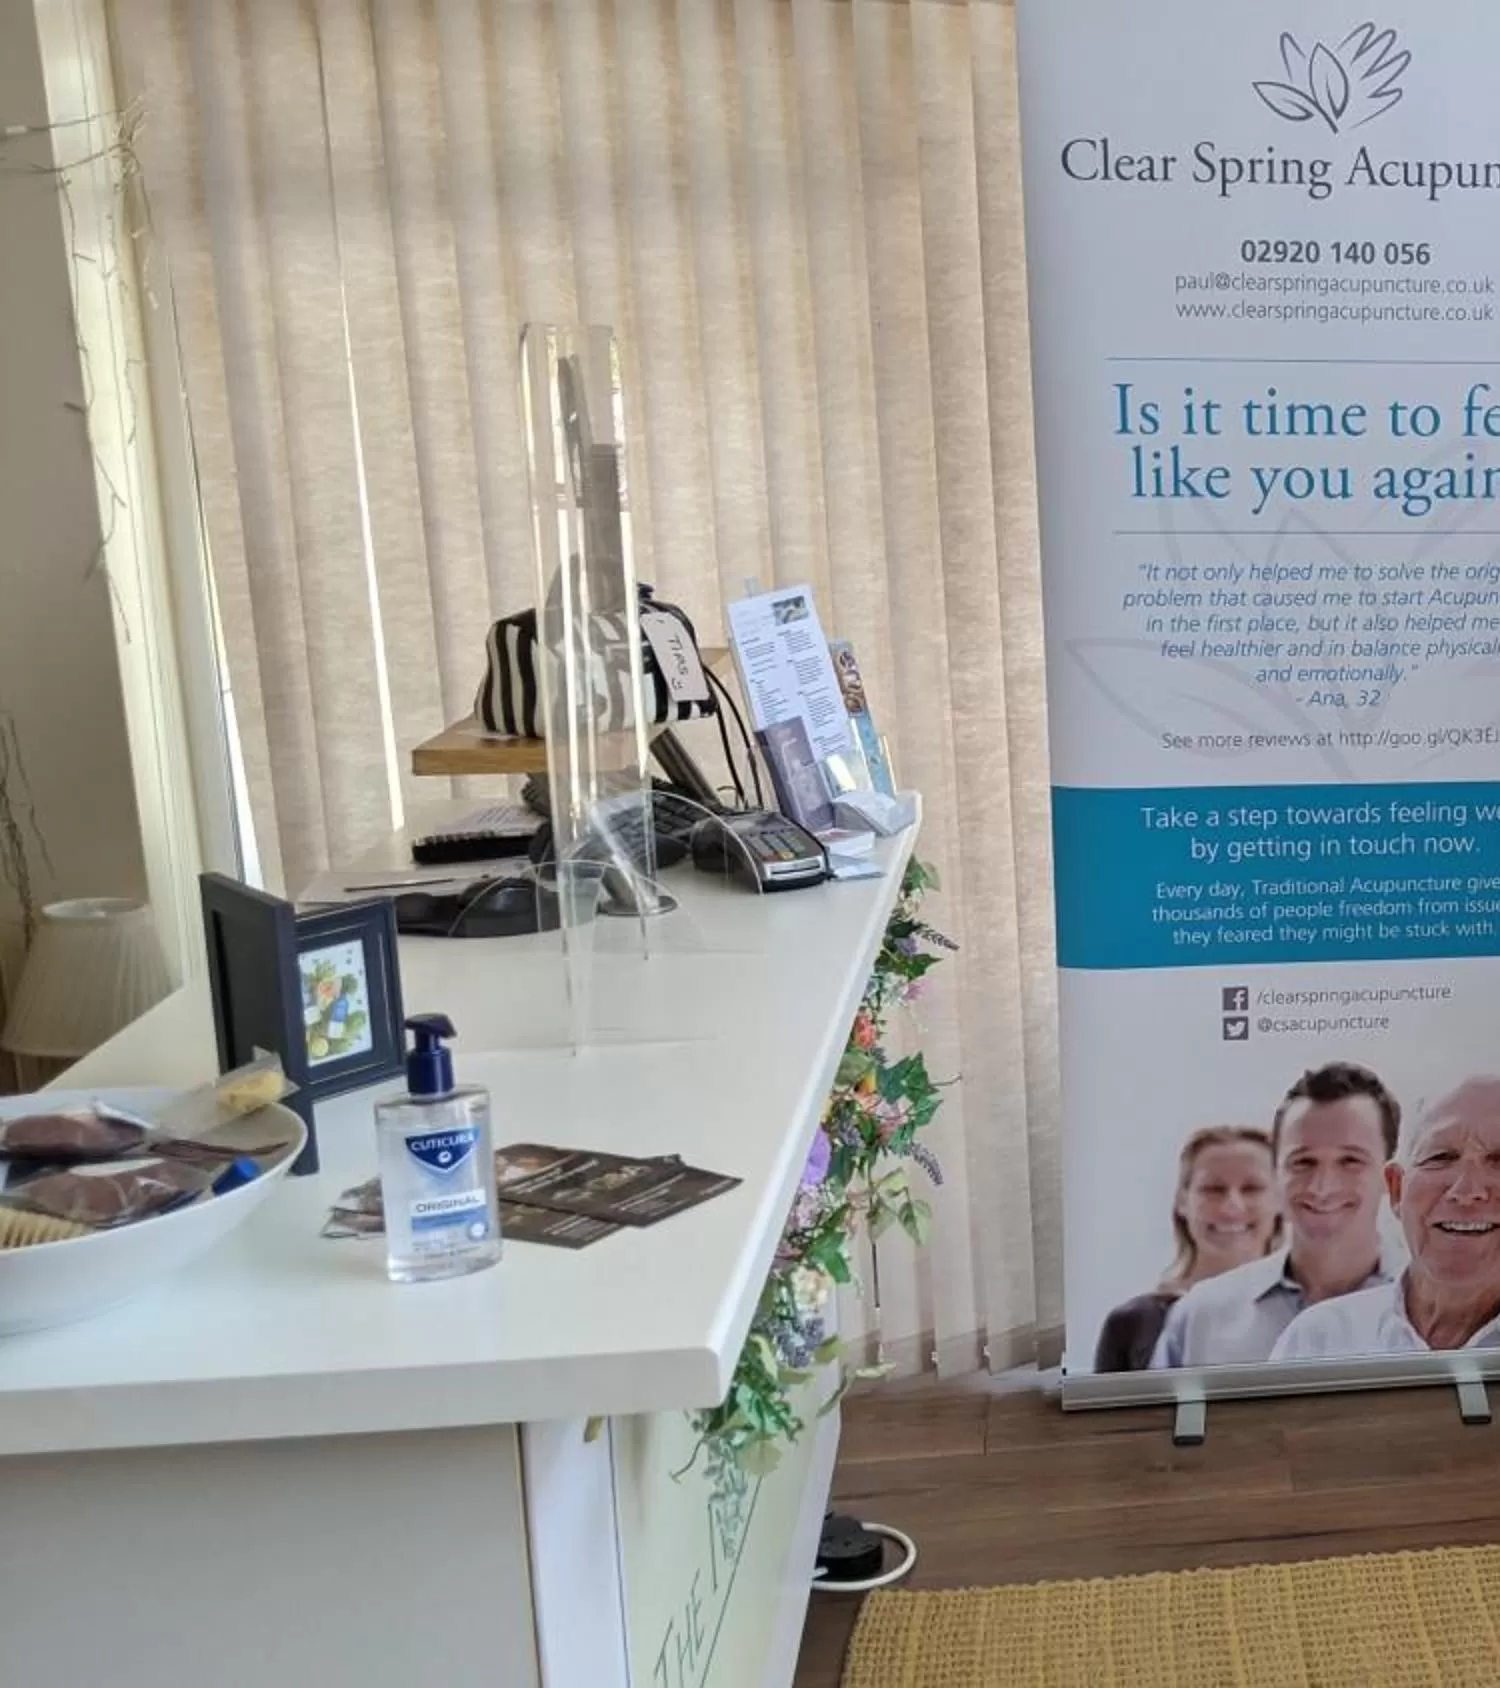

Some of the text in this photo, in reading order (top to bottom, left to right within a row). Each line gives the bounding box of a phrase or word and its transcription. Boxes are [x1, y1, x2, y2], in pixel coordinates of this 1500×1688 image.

[1061, 136, 1176, 183] Clear
[1193, 141, 1332, 200] Spring
[1241, 239, 1430, 265] 02920 140 056
[1175, 271, 1494, 297] paul@clearspringacupuncture.co.uk
[1175, 299, 1493, 324] www.clearspringacupuncture.co.uk
[1113, 383, 1159, 434] Is
[1183, 387, 1221, 435] it
[1243, 387, 1366, 436] time
[1388, 401, 1440, 436] to
[1131, 444, 1230, 498] like
[1249, 466, 1353, 516] you
[1165, 565, 1198, 581] not
[1203, 562, 1244, 585] only
[1249, 563, 1313, 584] helped
[1318, 567, 1348, 581] me
[1353, 564, 1372, 581] to
[1375, 562, 1424, 580] solve
[1431, 562, 1460, 580] the
[1122, 589, 1202, 610] problem
[1209, 587, 1246, 607] that
[1252, 589, 1317, 606] caused
[1322, 592, 1352, 606] me
[1358, 590, 1376, 605] to
[1381, 590, 1423, 606] start
[1145, 617, 1163, 632] in
[1170, 614, 1200, 632] the
[1207, 613, 1242, 632] first
[1247, 614, 1299, 635] place,
[1307, 614, 1339, 632] but
[1344, 614, 1357, 632] it
[1362, 613, 1398, 631] also
[1404, 612, 1467, 634] helped
[1471, 616, 1500, 630] me
[1161, 640, 1195, 657] feel
[1201, 639, 1283, 657] healthier
[1287, 639, 1324, 656] and
[1327, 639, 1345, 656] in
[1351, 638, 1421, 656] balance
[1256, 662, 1292, 681] and
[1308, 690, 1348, 709] Ana,
[1357, 689, 1381, 706] 32
[1162, 732, 1192, 748] See
[1198, 735, 1242, 748] more
[1248, 734, 1311, 748] reviews
[1316, 732, 1332, 746] at
[1140, 805, 1198, 828] Take
[1205, 810, 1219, 826] a
[1228, 806, 1277, 830] step
[1287, 801, 1381, 825] towards
[1389, 800, 1466, 828] feeling
[1191, 831, 1480, 863] by getting in touch now.
[1156, 882, 1203, 901] Every
[1208, 879, 1244, 900] day,
[1251, 877, 1344, 895] Traditional
[1349, 875, 1462, 895] Acupuncture
[1152, 903, 1244, 921] thousands
[1249, 901, 1267, 919] of
[1273, 900, 1333, 921] people
[1339, 898, 1411, 916] freedom
[1418, 897, 1458, 914] from
[1173, 927, 1211, 947] they
[1217, 924, 1273, 943] feared
[1279, 925, 1317, 944] they
[1322, 922, 1372, 943] might
[1378, 921, 1401, 938] be
[1405, 920, 1448, 937] stuck
[1257, 984, 1451, 1008] /clearspringacupuncture
[1258, 1013, 1389, 1035] @csacupuncture
[411, 1132, 475, 1152] CUTICURA
[416, 1195, 478, 1213] ORIGINAL
